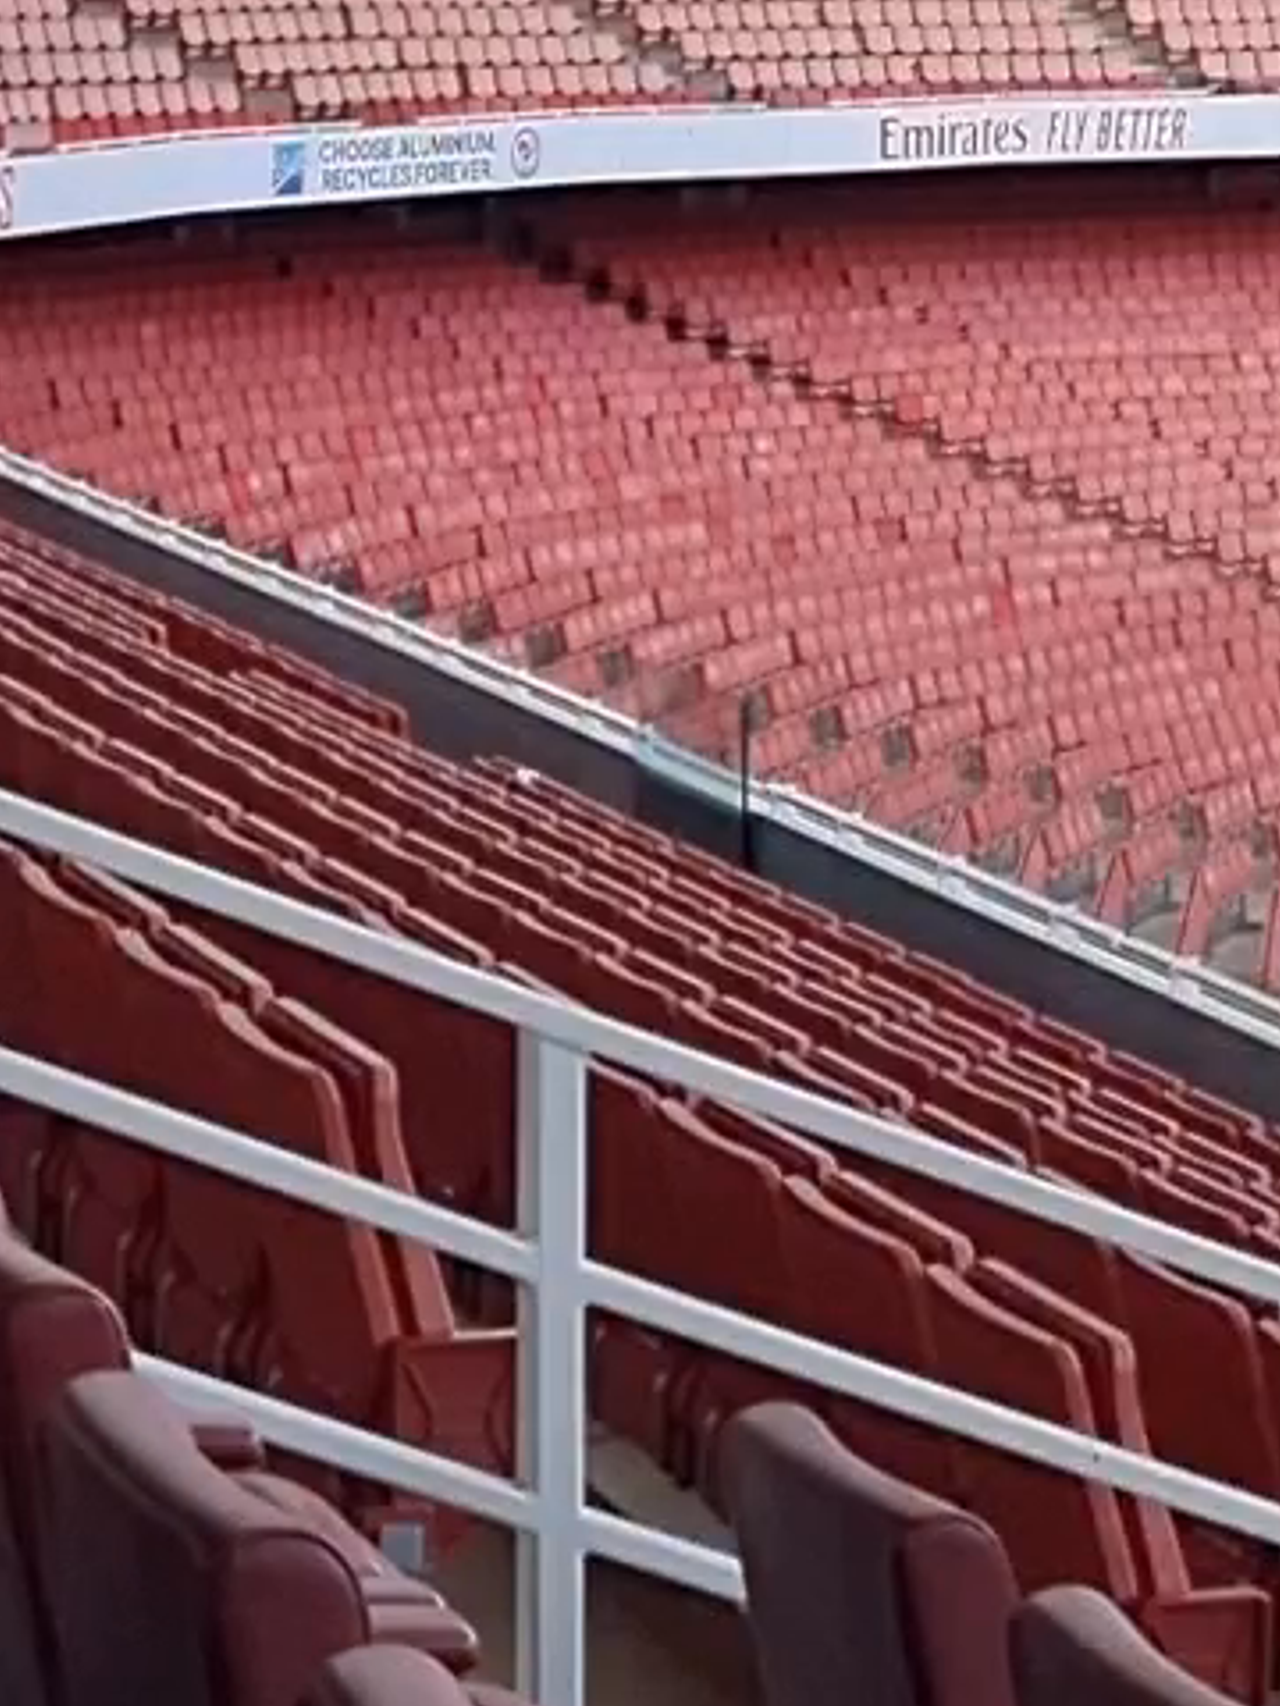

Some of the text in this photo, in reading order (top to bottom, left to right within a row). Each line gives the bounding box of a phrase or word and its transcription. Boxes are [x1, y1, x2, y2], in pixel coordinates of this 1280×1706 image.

[879, 106, 1190, 161] Emirates FLY BETTER
[320, 136, 394, 163] CHOOSE
[321, 164, 413, 192] RECYCLES
